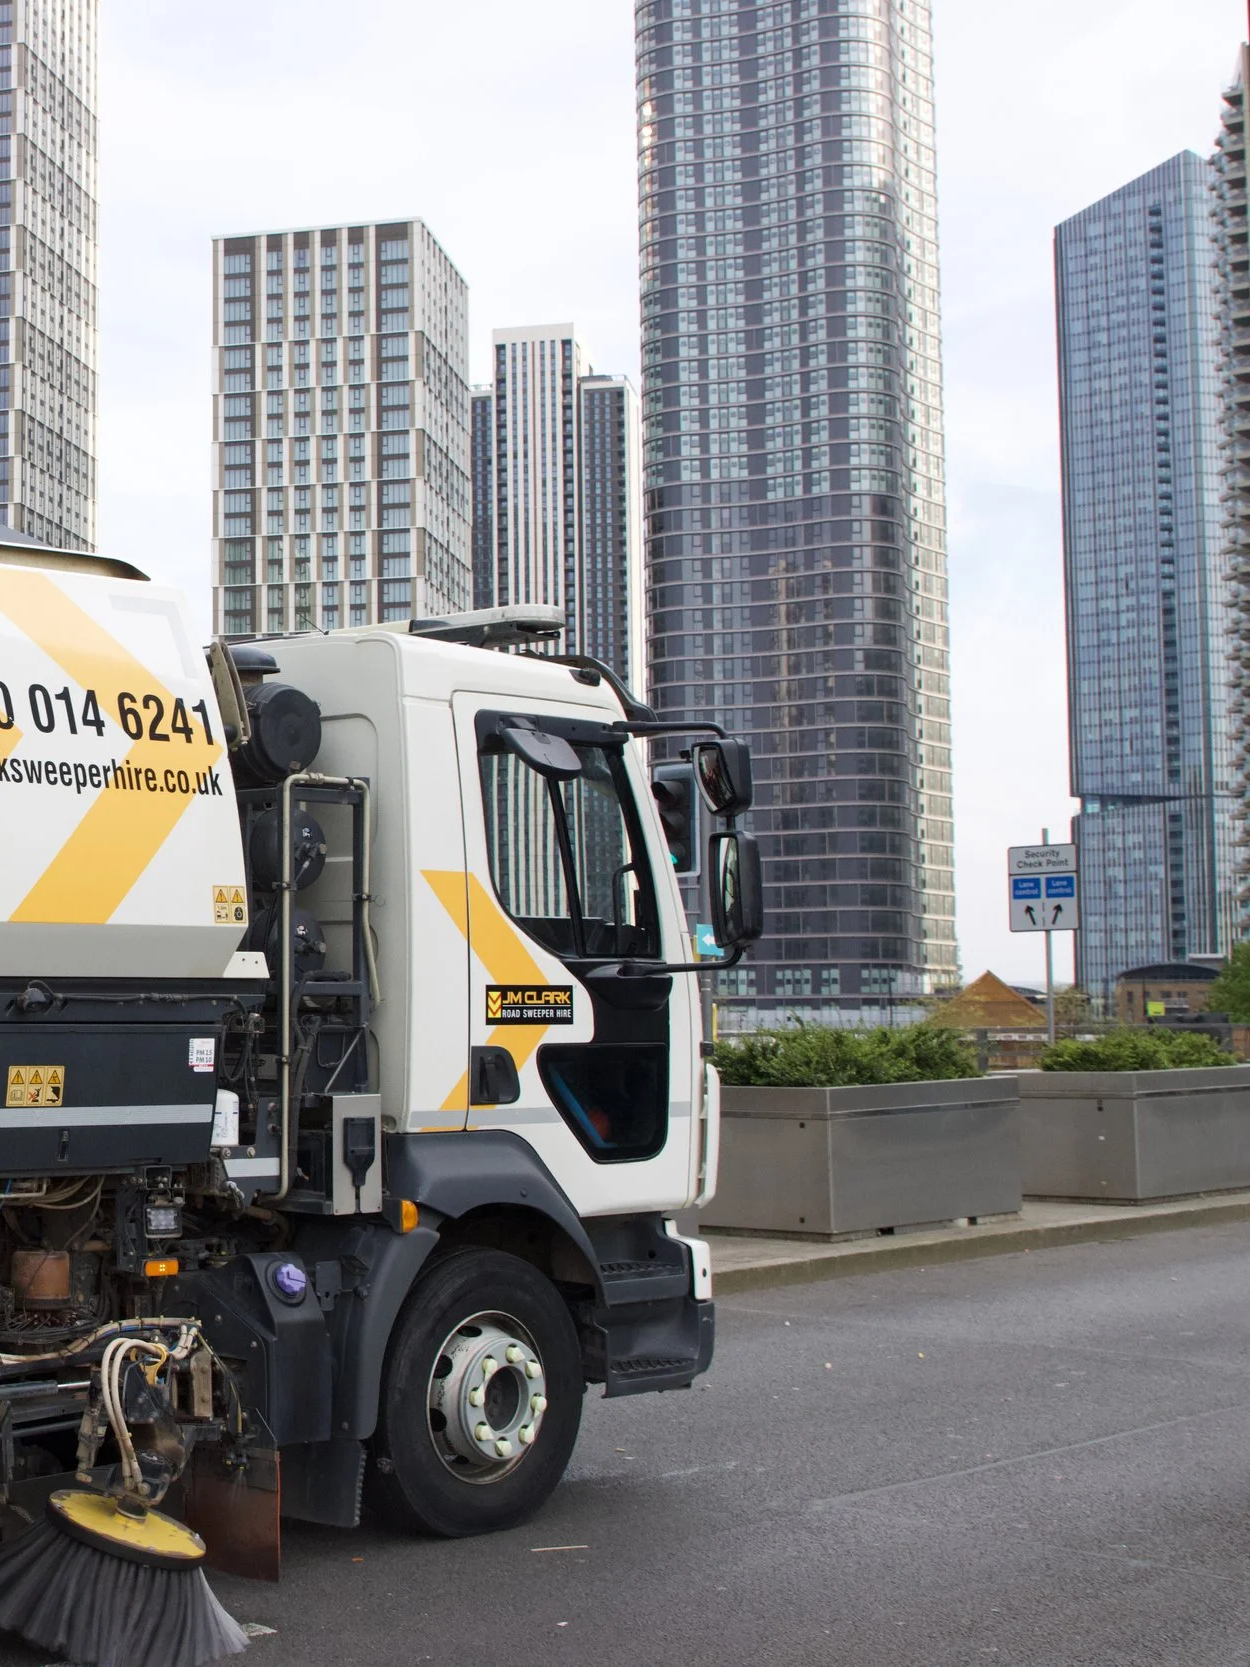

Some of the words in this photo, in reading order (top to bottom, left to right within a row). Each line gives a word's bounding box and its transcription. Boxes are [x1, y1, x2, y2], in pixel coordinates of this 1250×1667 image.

[28, 683, 105, 737] 014
[118, 691, 215, 746] 6241
[1024, 850, 1060, 859] Security
[1016, 860, 1043, 869] Check
[1046, 858, 1069, 867] Point
[1014, 888, 1039, 896] control
[1048, 887, 1072, 895] control
[502, 991, 523, 1004] JM
[524, 991, 571, 1004] CLARK
[502, 1009, 521, 1018] ROAD
[523, 1009, 554, 1018] SWEEPER
[556, 1009, 572, 1018] HIRE
